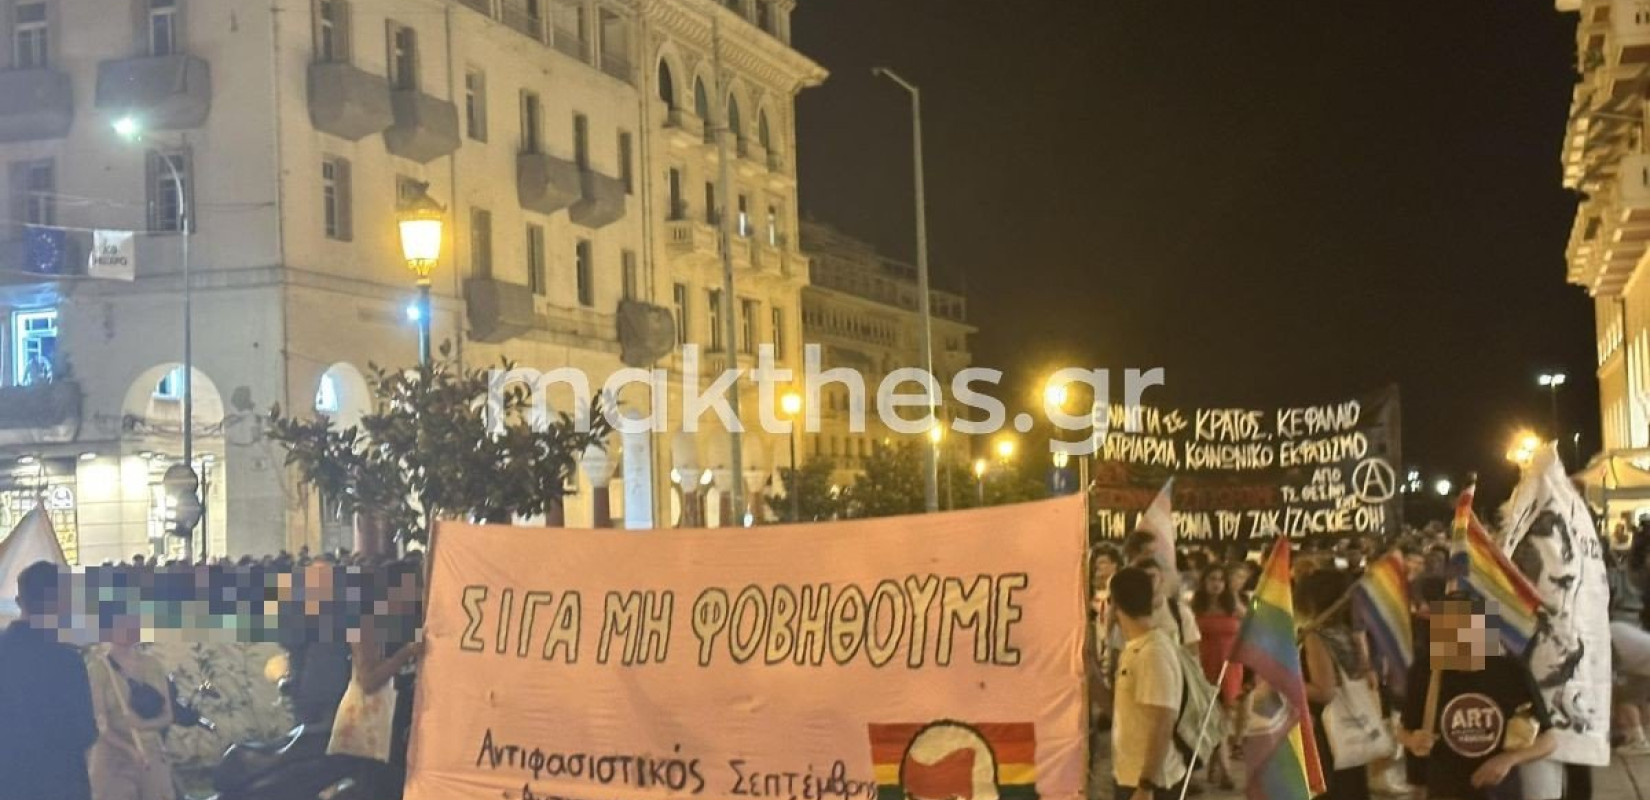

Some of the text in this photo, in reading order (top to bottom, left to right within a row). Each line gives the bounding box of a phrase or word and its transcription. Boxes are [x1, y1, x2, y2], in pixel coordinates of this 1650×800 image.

[1277, 399, 1361, 438] ΚΕΦΑΛΑΙΟ
[1185, 440, 1274, 471] ΚΟΙΝΩΝΙΚΟ
[1097, 509, 1126, 539] ΤΗΝ
[1215, 510, 1241, 541] ΤΟΥ
[460, 573, 1028, 669] ΣΙΓΑ ΜΗ ΦΟΒΗΘΟΥΜΕ
[1451, 706, 1496, 730] ART
[476, 727, 705, 795] Αντιφασιστικός
